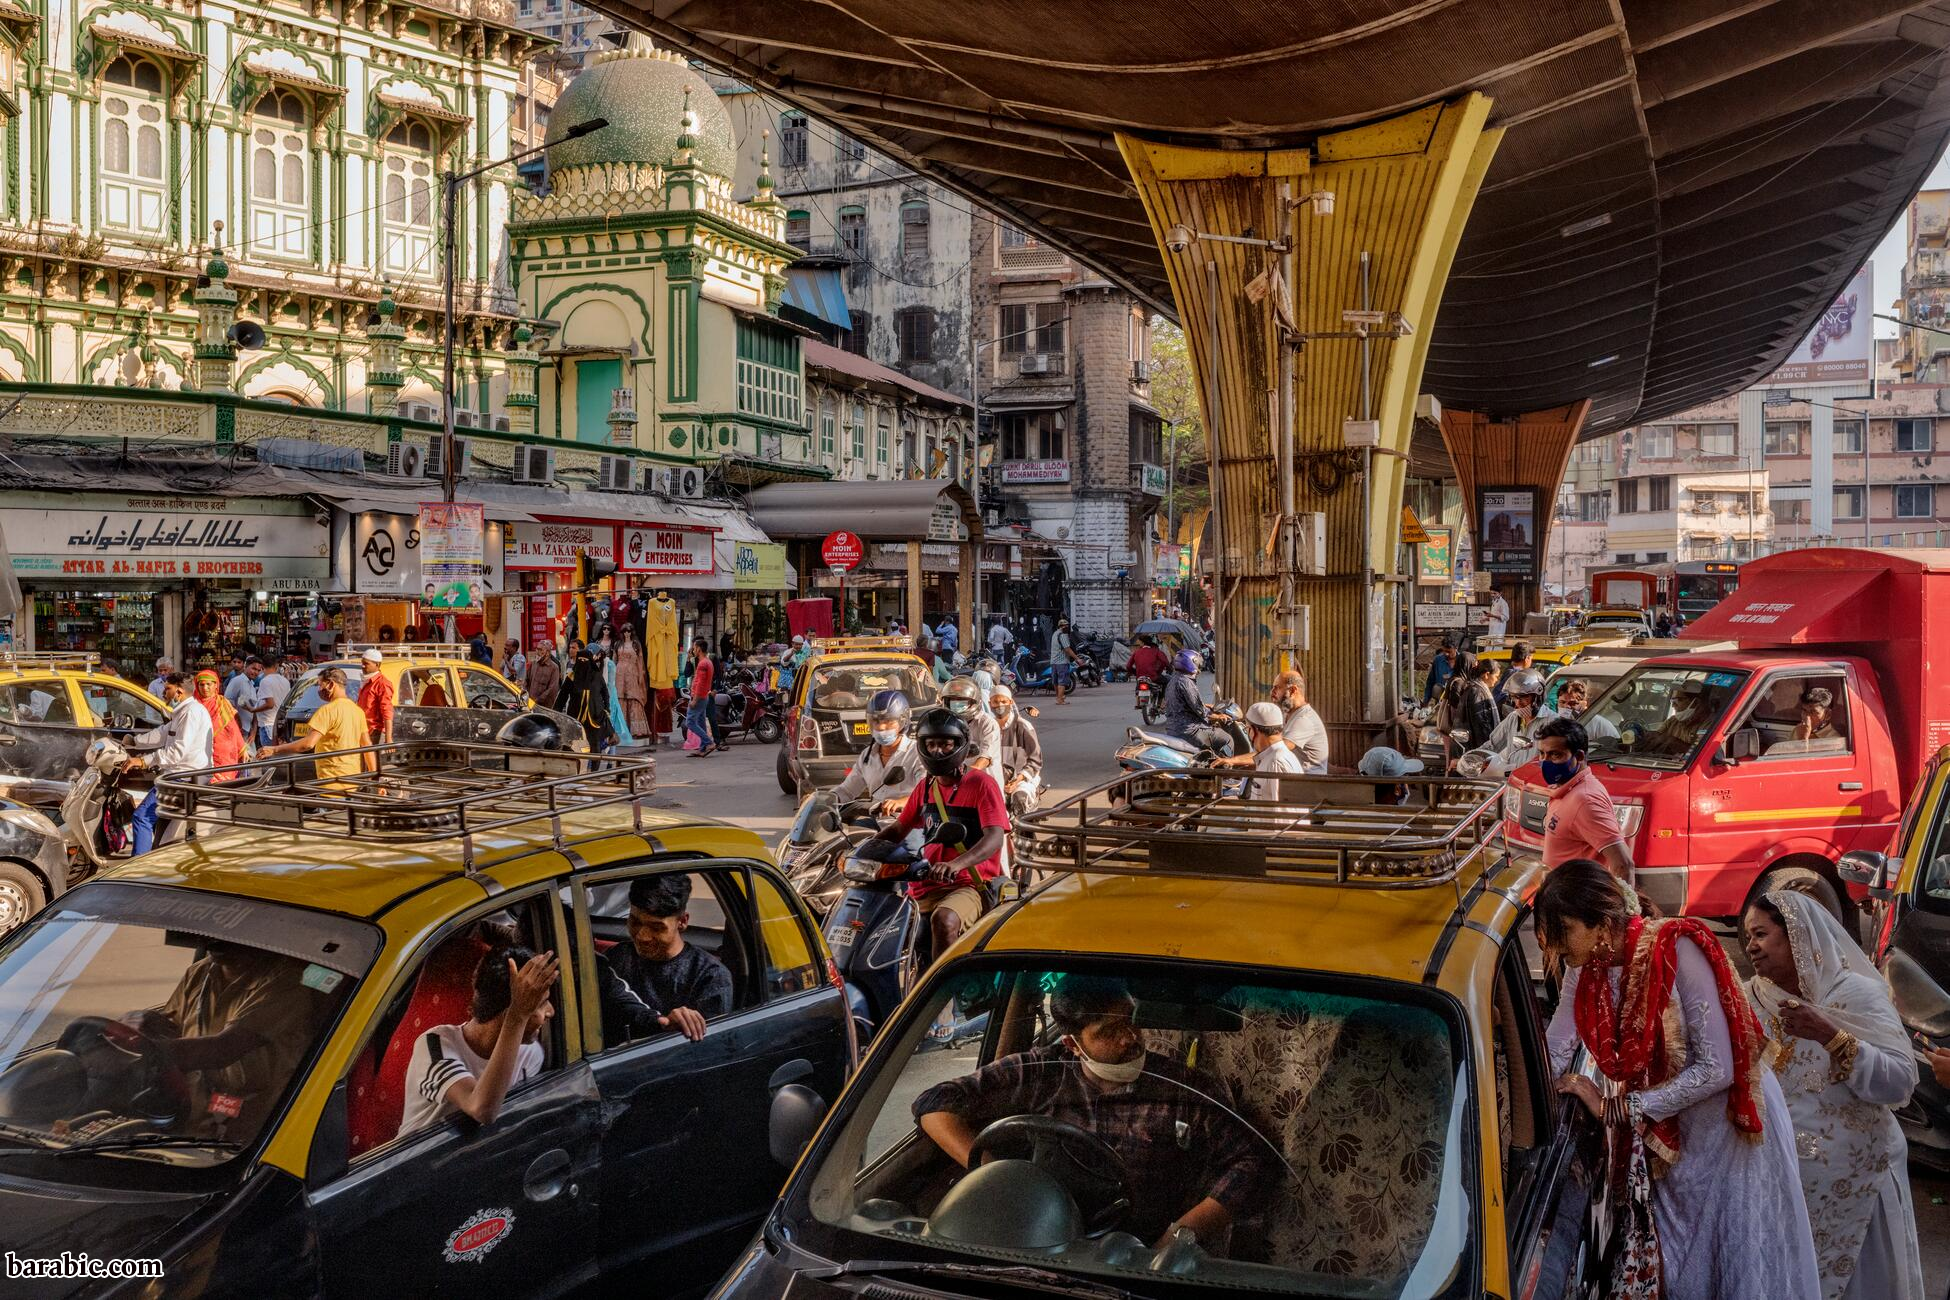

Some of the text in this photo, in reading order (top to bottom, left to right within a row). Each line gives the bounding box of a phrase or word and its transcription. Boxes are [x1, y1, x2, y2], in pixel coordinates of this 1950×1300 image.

[1822, 311, 1849, 324] NYC
[656, 531, 683, 550] MOIN
[588, 545, 613, 558] BROS.
[645, 551, 693, 566] ENTERPRISES
[63, 559, 105, 575] ATTAR
[197, 561, 263, 576] BROTHERS
[272, 579, 321, 589] ABU BABA
